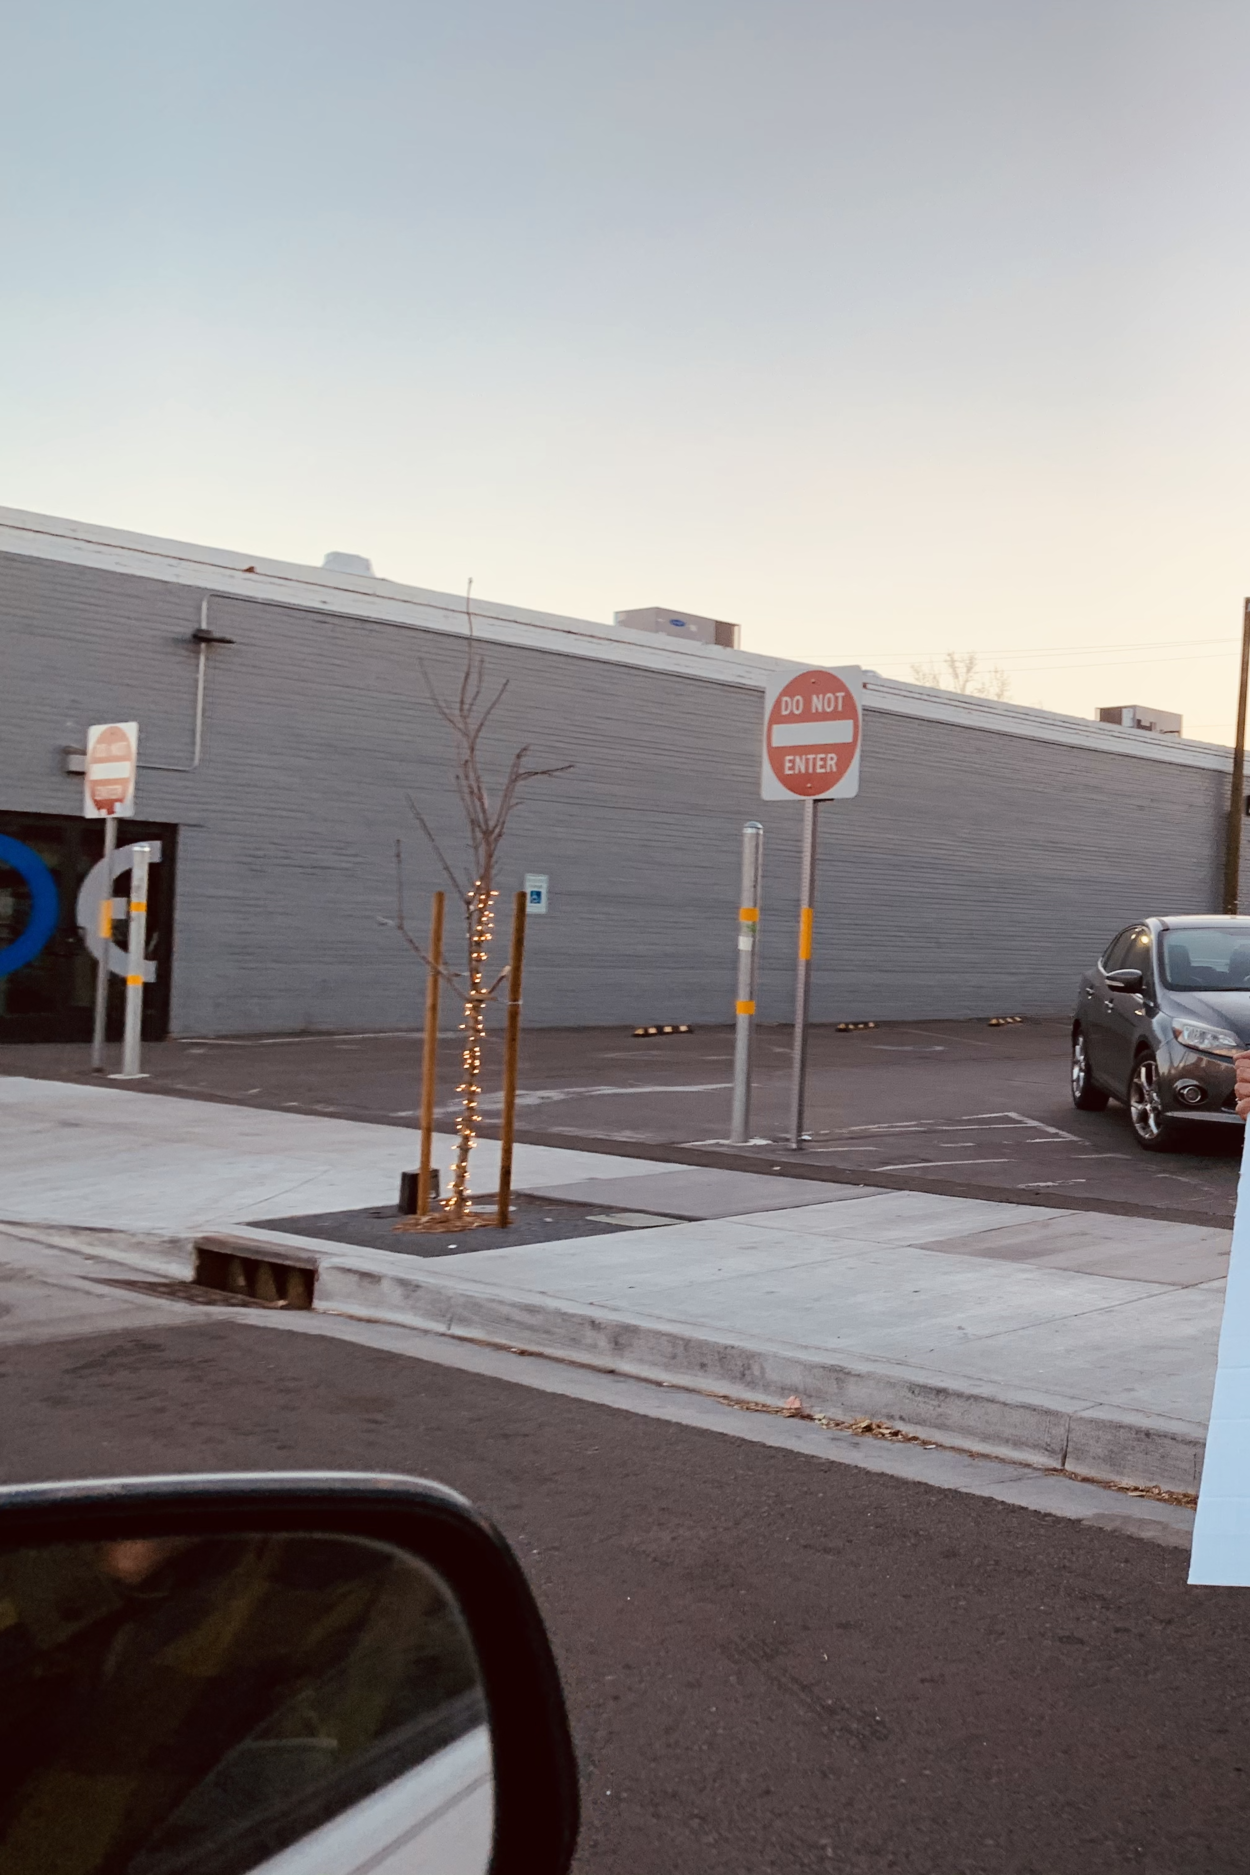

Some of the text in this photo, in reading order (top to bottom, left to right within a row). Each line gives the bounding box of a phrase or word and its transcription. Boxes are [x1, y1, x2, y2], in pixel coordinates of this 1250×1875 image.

[781, 692, 845, 715] DO NOT
[784, 753, 838, 775] ENTER
